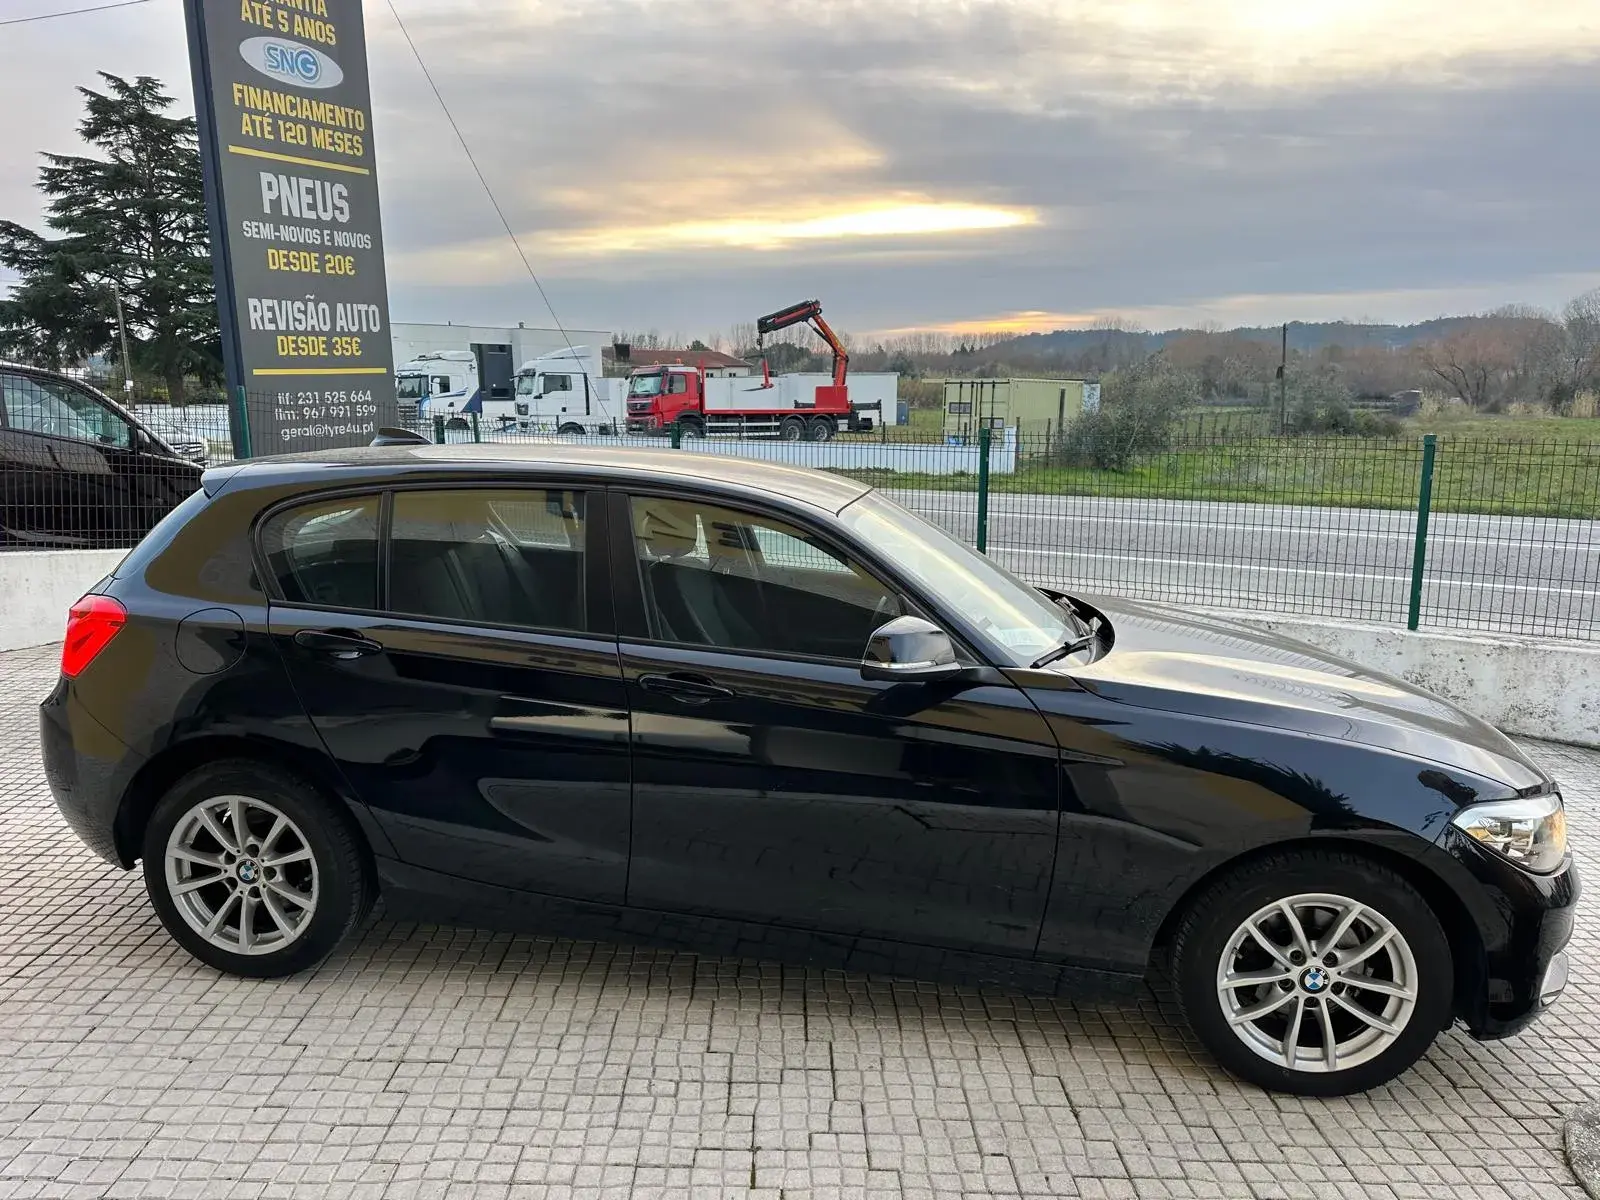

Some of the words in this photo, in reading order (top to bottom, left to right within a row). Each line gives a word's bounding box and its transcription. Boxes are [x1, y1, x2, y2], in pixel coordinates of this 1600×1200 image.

[241, 0, 273, 29] ATÉ
[277, 9, 289, 33] 5
[294, 14, 337, 46] ANOS
[264, 44, 321, 83] SNG
[233, 82, 365, 131] FINANCIAMENTO
[241, 112, 274, 141] ATÉ
[278, 120, 307, 146] 120
[311, 126, 363, 157] MESES
[259, 171, 350, 223] PNEUS
[242, 220, 321, 245] SEMI-NOVOS
[324, 229, 332, 246] E
[334, 231, 372, 250] NOVOS
[267, 248, 321, 274] DESDE
[325, 254, 356, 276] 20€
[247, 294, 330, 332] REVISÃO
[335, 303, 381, 333] AUTO
[277, 335, 328, 357] DESDE
[332, 336, 362, 356] 35€
[297, 391, 320, 405] 231
[324, 391, 347, 404] 525
[350, 389, 372, 403] 664
[302, 406, 327, 420] 967
[329, 405, 351, 418] 991
[355, 403, 377, 417] 599
[280, 421, 375, 441] geral@tyre4u.pt
